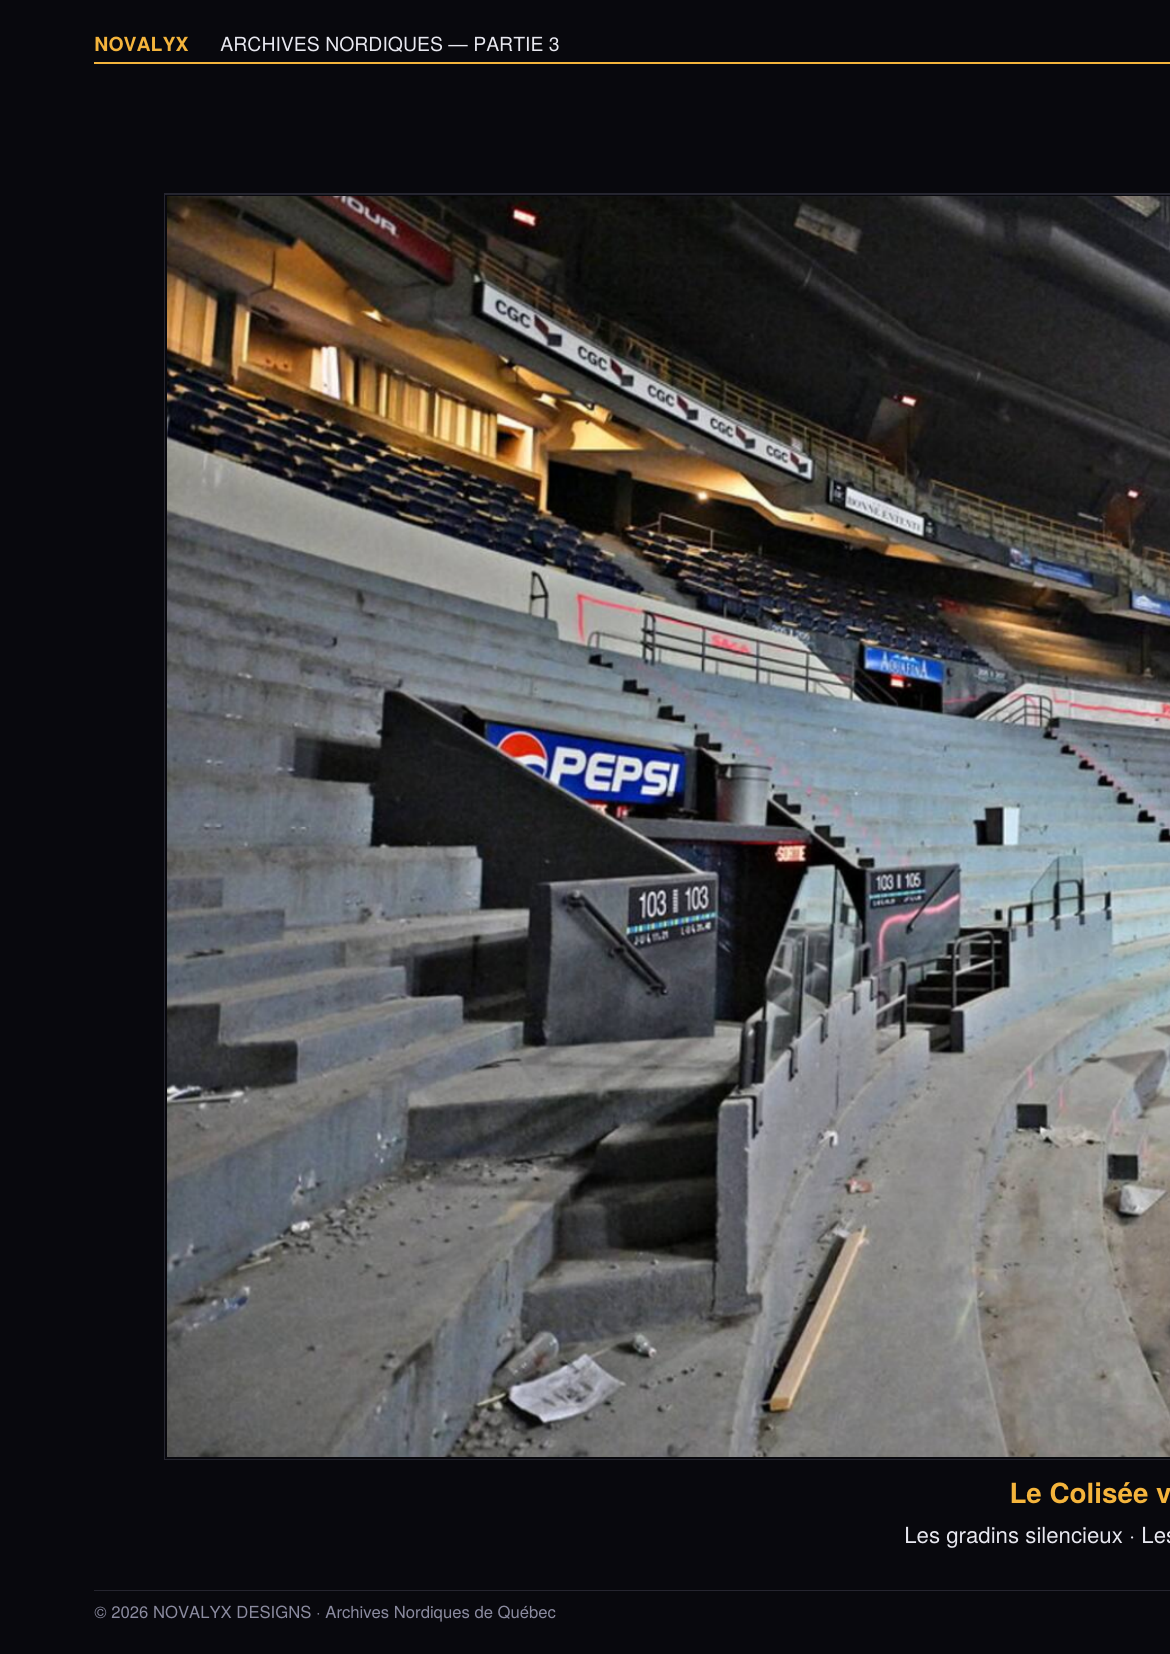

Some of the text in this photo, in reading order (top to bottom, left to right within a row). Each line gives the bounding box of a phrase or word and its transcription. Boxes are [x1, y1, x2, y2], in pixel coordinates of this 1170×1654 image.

[494, 299, 531, 329] CGC
[577, 345, 608, 371] CGC
[646, 384, 675, 407] CGC
[709, 417, 734, 438] CGC
[765, 444, 789, 463] CGC
[549, 745, 680, 798] PEPSI
[876, 873, 895, 891] 103
[638, 885, 710, 919] 103 103
